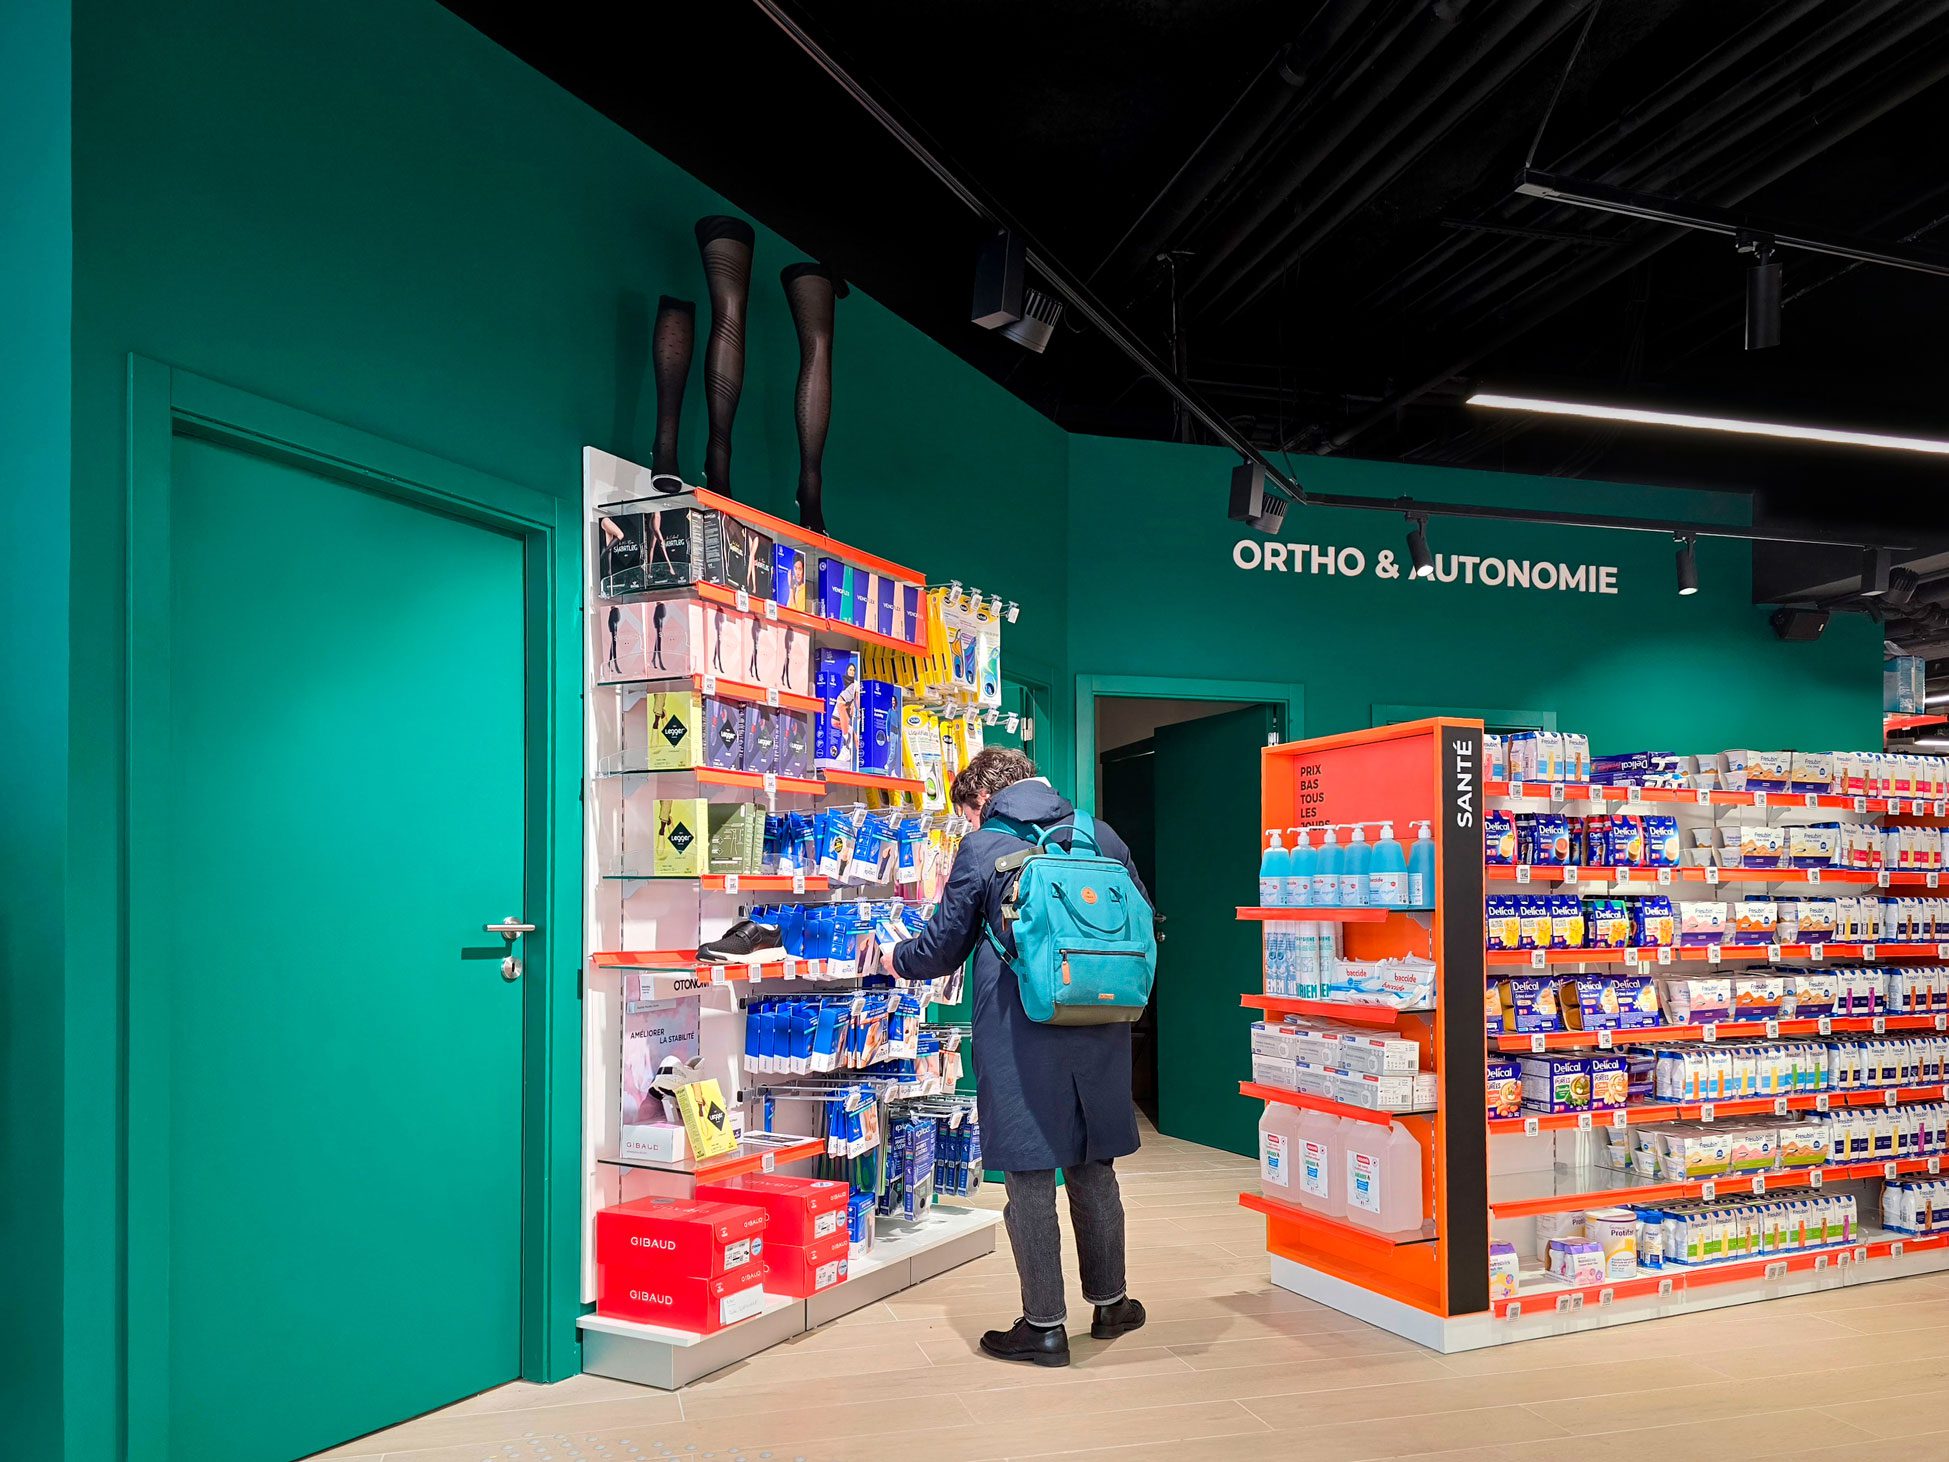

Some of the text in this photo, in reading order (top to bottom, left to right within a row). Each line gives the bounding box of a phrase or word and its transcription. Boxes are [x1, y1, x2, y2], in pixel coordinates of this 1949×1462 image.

[1232, 539, 1365, 577] ORTHO
[1375, 549, 1400, 580] &
[1300, 764, 1321, 776] PRIX
[1300, 779, 1319, 790] BAS
[1453, 740, 1473, 828] SANTÉ
[1300, 792, 1325, 804] TOUS
[1300, 807, 1317, 818] LES
[1485, 821, 1510, 830] Delical
[1539, 824, 1564, 834] Delical
[1613, 827, 1637, 836] Delical
[1649, 827, 1674, 836] Delical
[1488, 905, 1515, 916] Delical
[1520, 905, 1547, 916] Delical
[1551, 905, 1578, 916] Delical
[1595, 909, 1621, 919] Delical
[1644, 906, 1669, 916] Delical
[1346, 968, 1367, 977] baccide
[1394, 973, 1417, 983] baccide
[1512, 980, 1539, 991] Delical
[1577, 980, 1602, 991] Delical
[1613, 978, 1641, 989] Delical
[630, 1028, 665, 1039] AMÉLIORER
[668, 1031, 695, 1043] STABILITÉ
[1553, 1061, 1581, 1073] Delical
[1592, 1059, 1619, 1070] Delical
[630, 1236, 676, 1251] GIBAUD
[629, 1289, 673, 1305] GIBAUD
